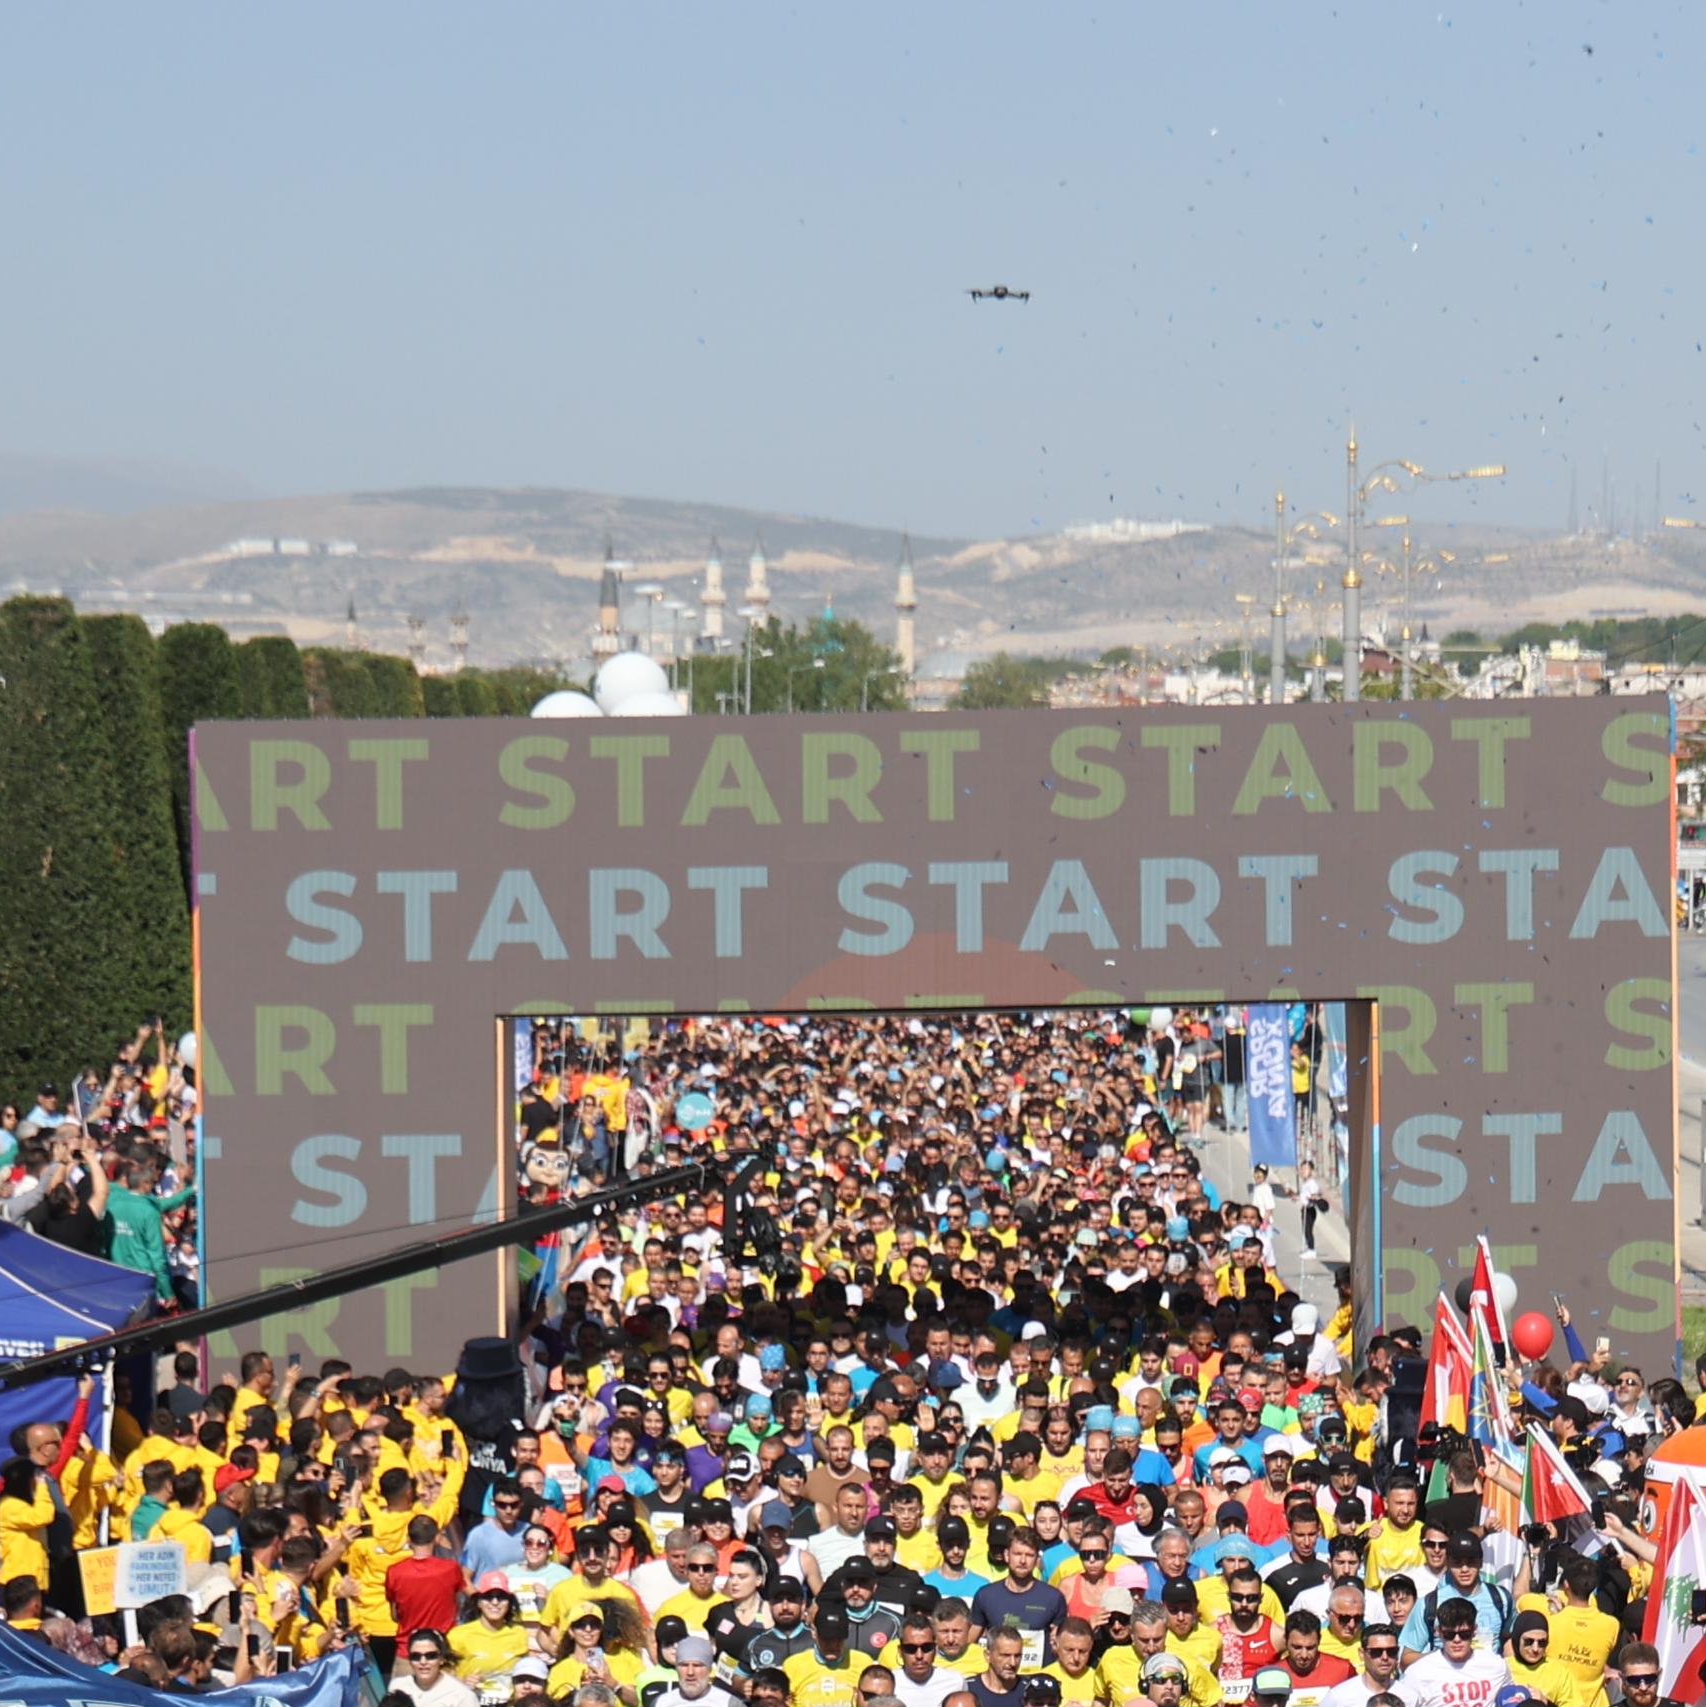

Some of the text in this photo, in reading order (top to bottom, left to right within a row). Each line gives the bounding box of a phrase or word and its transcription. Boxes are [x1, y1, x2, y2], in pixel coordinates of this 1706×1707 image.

[499, 716, 1531, 829] START START
[285, 847, 1668, 962] START START STA
[291, 1111, 1671, 1227] ST STA
[1442, 1680, 1491, 1704] STOP
